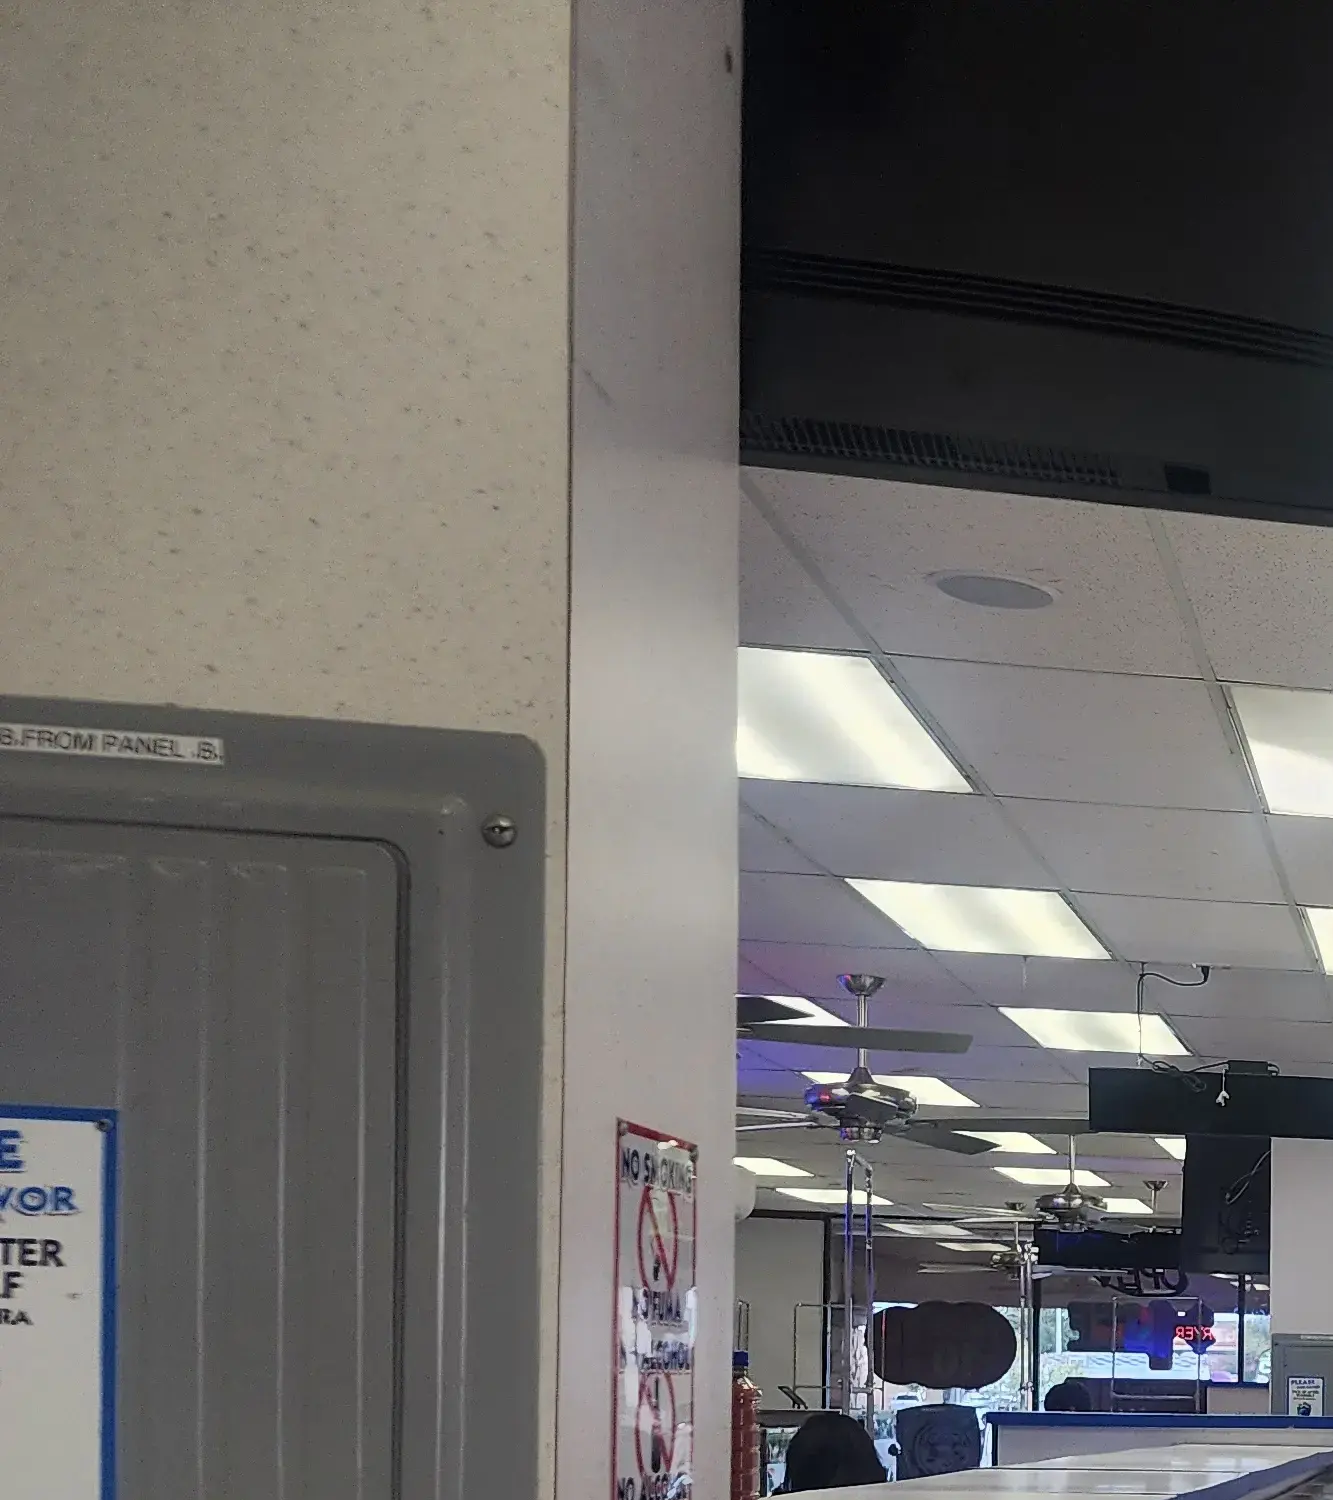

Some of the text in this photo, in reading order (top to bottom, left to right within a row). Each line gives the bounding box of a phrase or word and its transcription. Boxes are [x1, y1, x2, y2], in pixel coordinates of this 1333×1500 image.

[102, 734, 185, 758] PANEL
[621, 1149, 693, 1194] NO SMOKING
